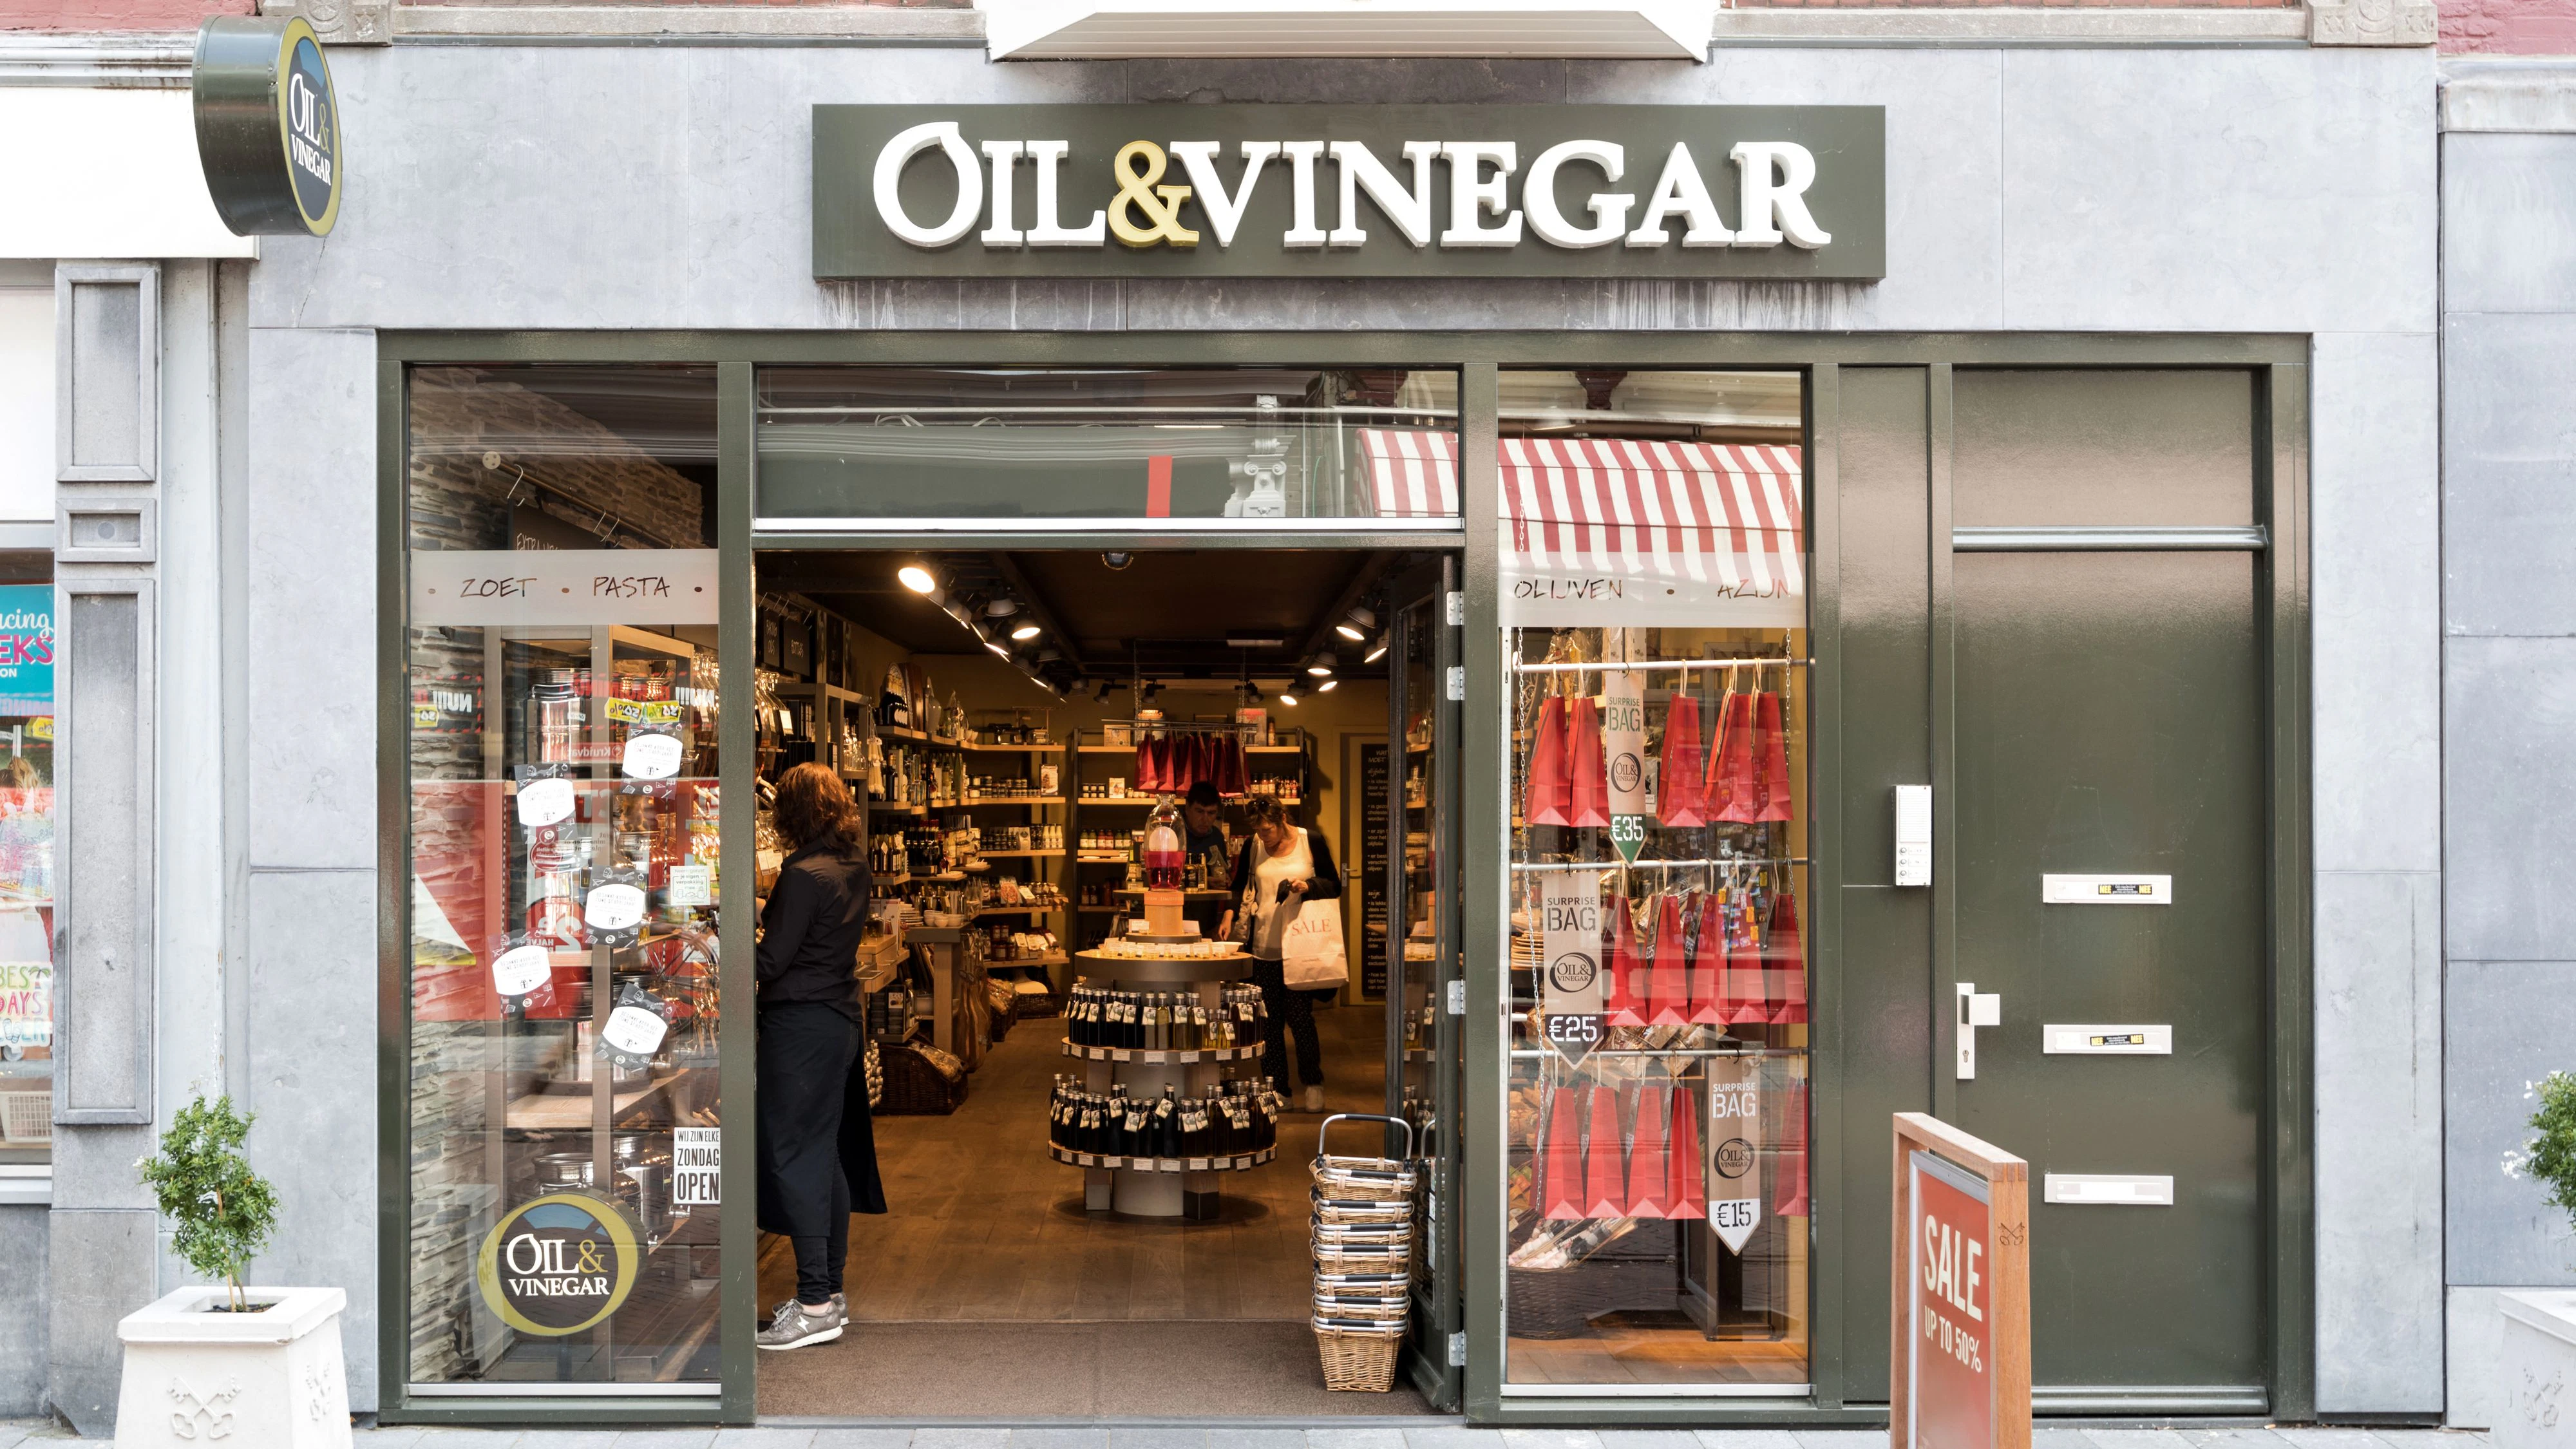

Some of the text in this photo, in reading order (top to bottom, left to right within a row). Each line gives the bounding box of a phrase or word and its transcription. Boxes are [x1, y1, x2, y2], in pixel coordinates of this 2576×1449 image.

[290, 73, 331, 155] OIL&
[290, 133, 331, 186] VINEGAR
[460, 576, 670, 598] ZOET PASTA
[1514, 579, 1622, 600] OLIJVEN
[1609, 696, 1640, 706] SURPRISE
[1608, 706, 1641, 732] BAG
[1615, 762, 1638, 777] OIL&
[1611, 815, 1643, 842] €35
[2099, 886, 2112, 894] NEE
[2138, 885, 2152, 894] NEE
[1547, 896, 1595, 906] SURPRISE
[1291, 918, 1332, 936] SALE
[1547, 907, 1596, 931] BAG
[1557, 962, 1592, 976] OIL&
[1548, 1016, 1598, 1042] €25
[2130, 1034, 2143, 1044] NEE
[2091, 1037, 2104, 1046] NEE
[1713, 1082, 1756, 1092] SURPRISE
[1712, 1092, 1756, 1119] BAG
[677, 1130, 719, 1142] WIJ ZIJN ELKE
[677, 1148, 719, 1166] ZONDAG
[1720, 1148, 1750, 1162] OIL&
[677, 1172, 719, 1200] OPEN
[1716, 1202, 1751, 1228] €15
[506, 1233, 609, 1275] OIL&
[1924, 1215, 1983, 1322] SALE
[507, 1276, 611, 1296] VINEGAR
[1924, 1304, 1982, 1374] UP TO 50%
